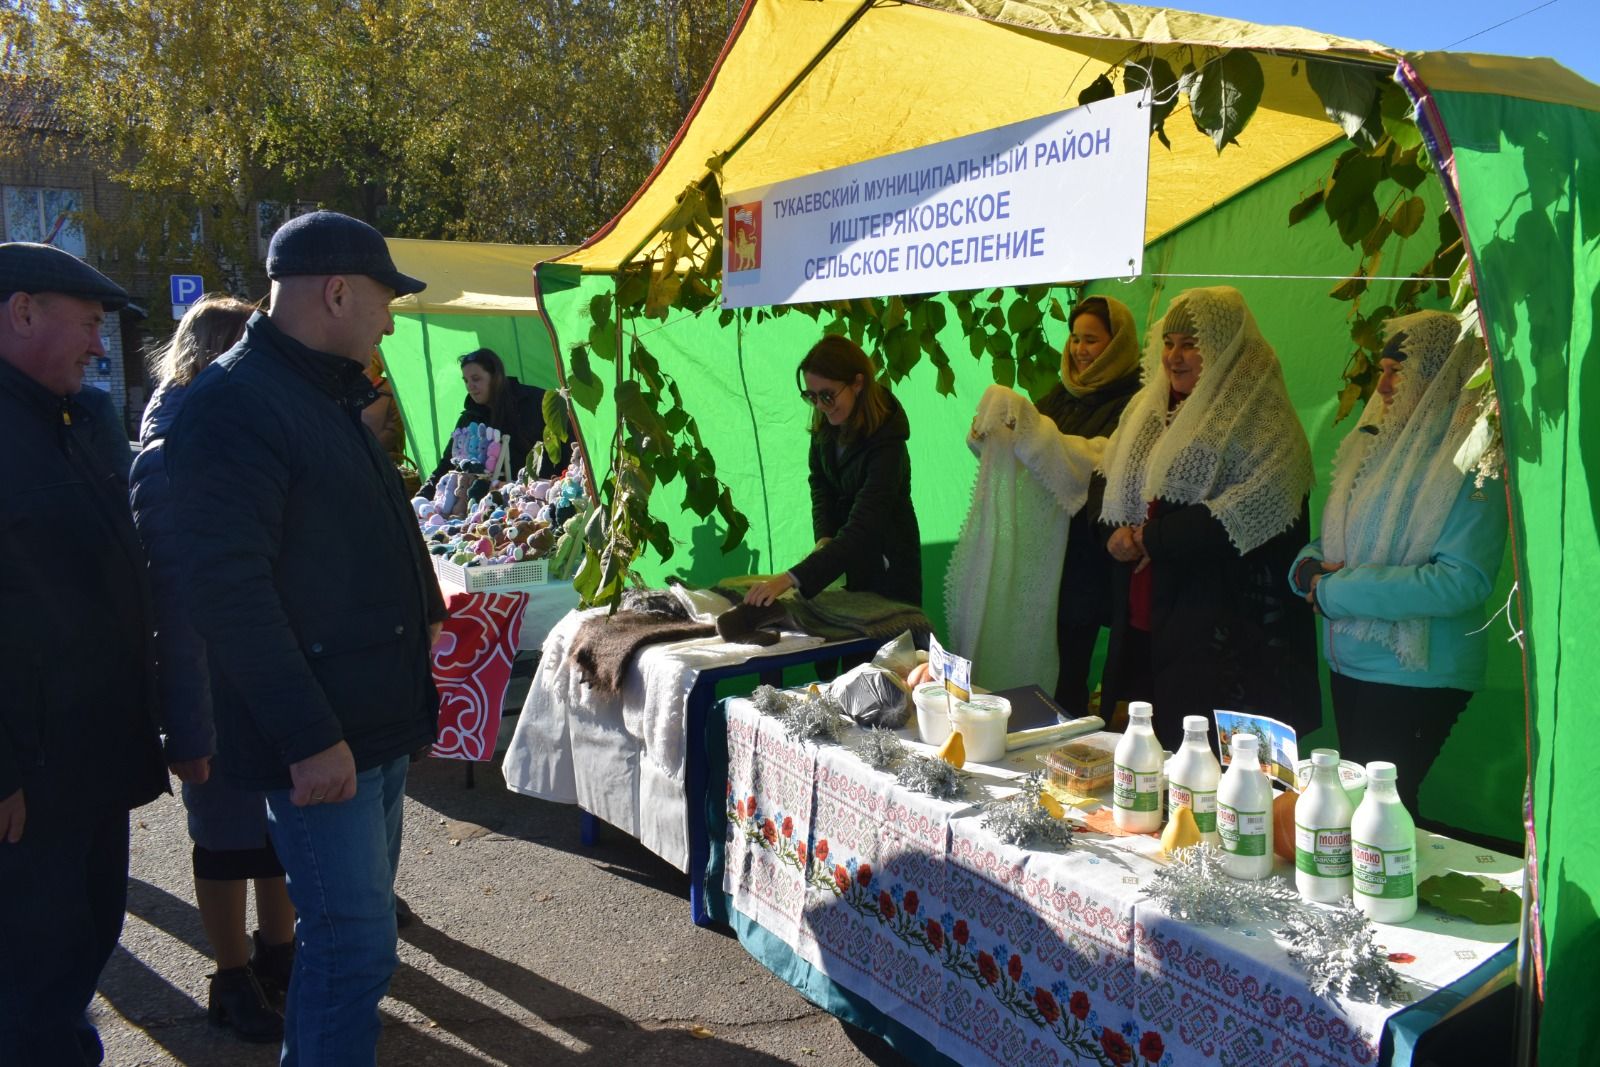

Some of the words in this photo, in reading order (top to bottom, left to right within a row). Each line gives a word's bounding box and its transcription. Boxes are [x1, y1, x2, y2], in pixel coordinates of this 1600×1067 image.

[773, 177, 860, 219] ТУКАЕВСКИЙ
[864, 140, 1028, 203] МУНИЦИПАЛЬНЫЙ
[1034, 127, 1111, 168] РАЙОН
[829, 190, 1011, 245] ИШТЕРЯКОВСКОЕ
[804, 247, 900, 281] СЕЛЬСКОЕ
[905, 227, 1046, 271] ПОСЕЛЕНИЕ
[178, 278, 196, 302] P
